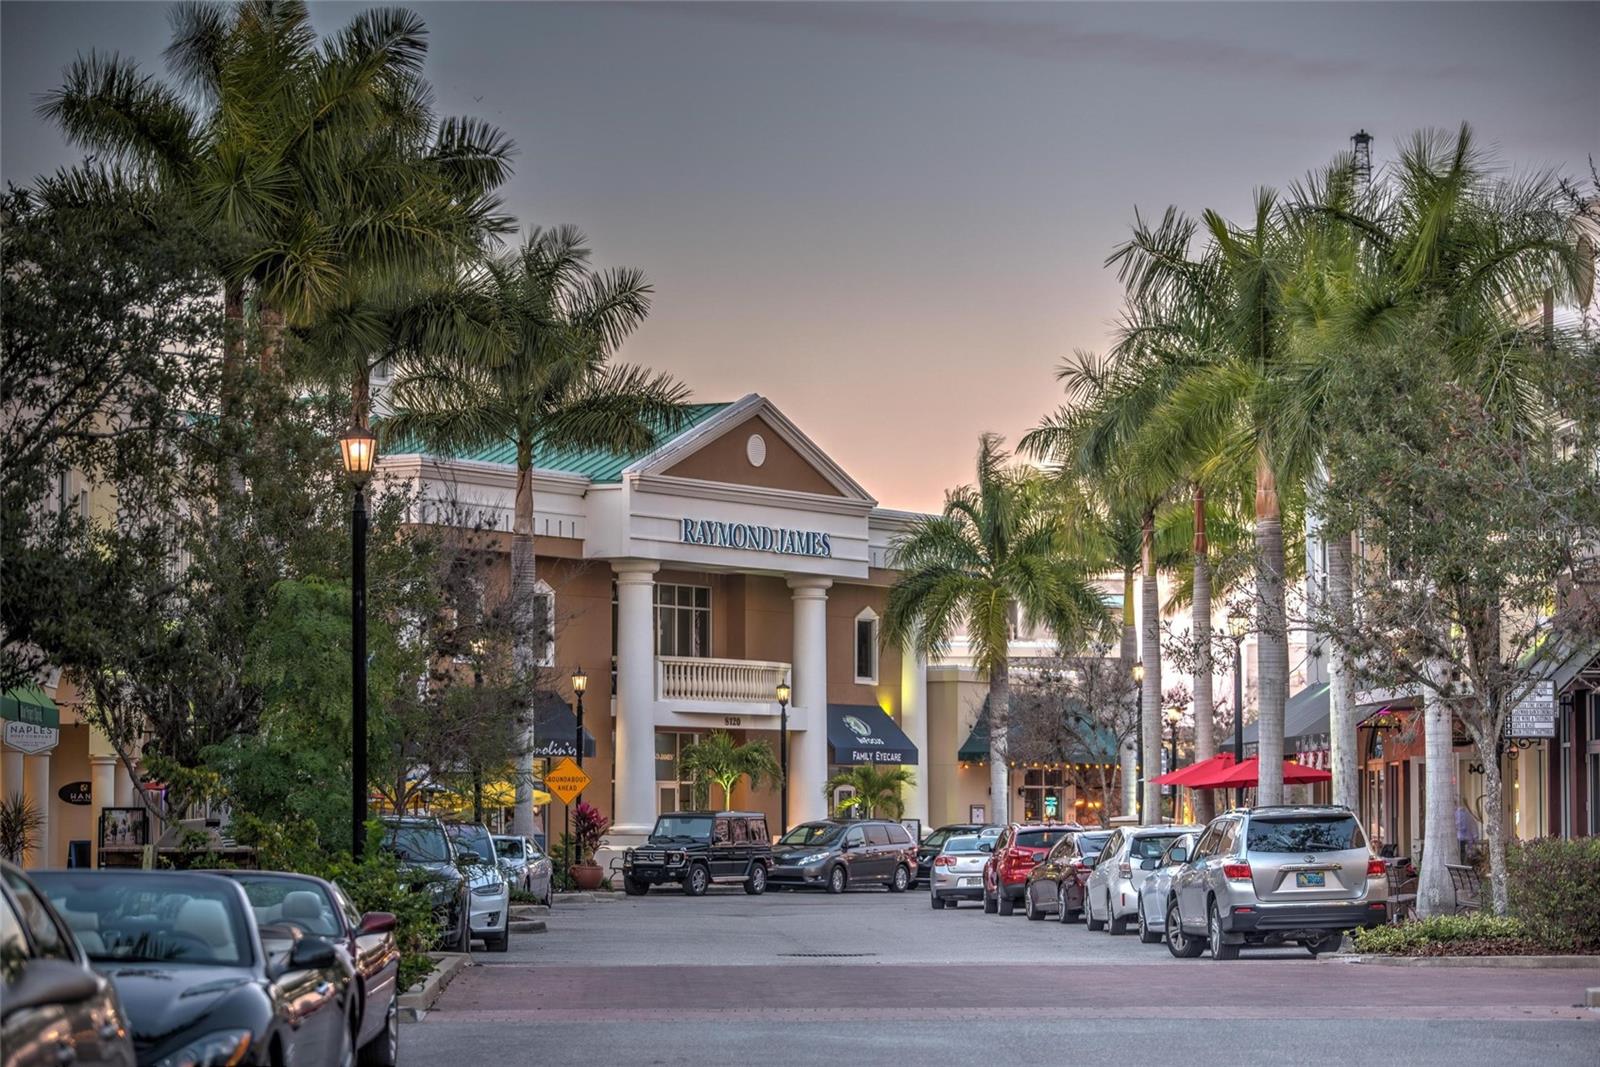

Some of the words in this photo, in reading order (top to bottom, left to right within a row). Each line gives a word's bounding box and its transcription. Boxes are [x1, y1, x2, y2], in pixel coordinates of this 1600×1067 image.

[682, 518, 774, 550] RAYMOND
[775, 527, 832, 558] JAMES
[10, 726, 53, 735] NAPLES
[852, 750, 873, 761] FAMILY
[875, 751, 902, 762] EYECARE
